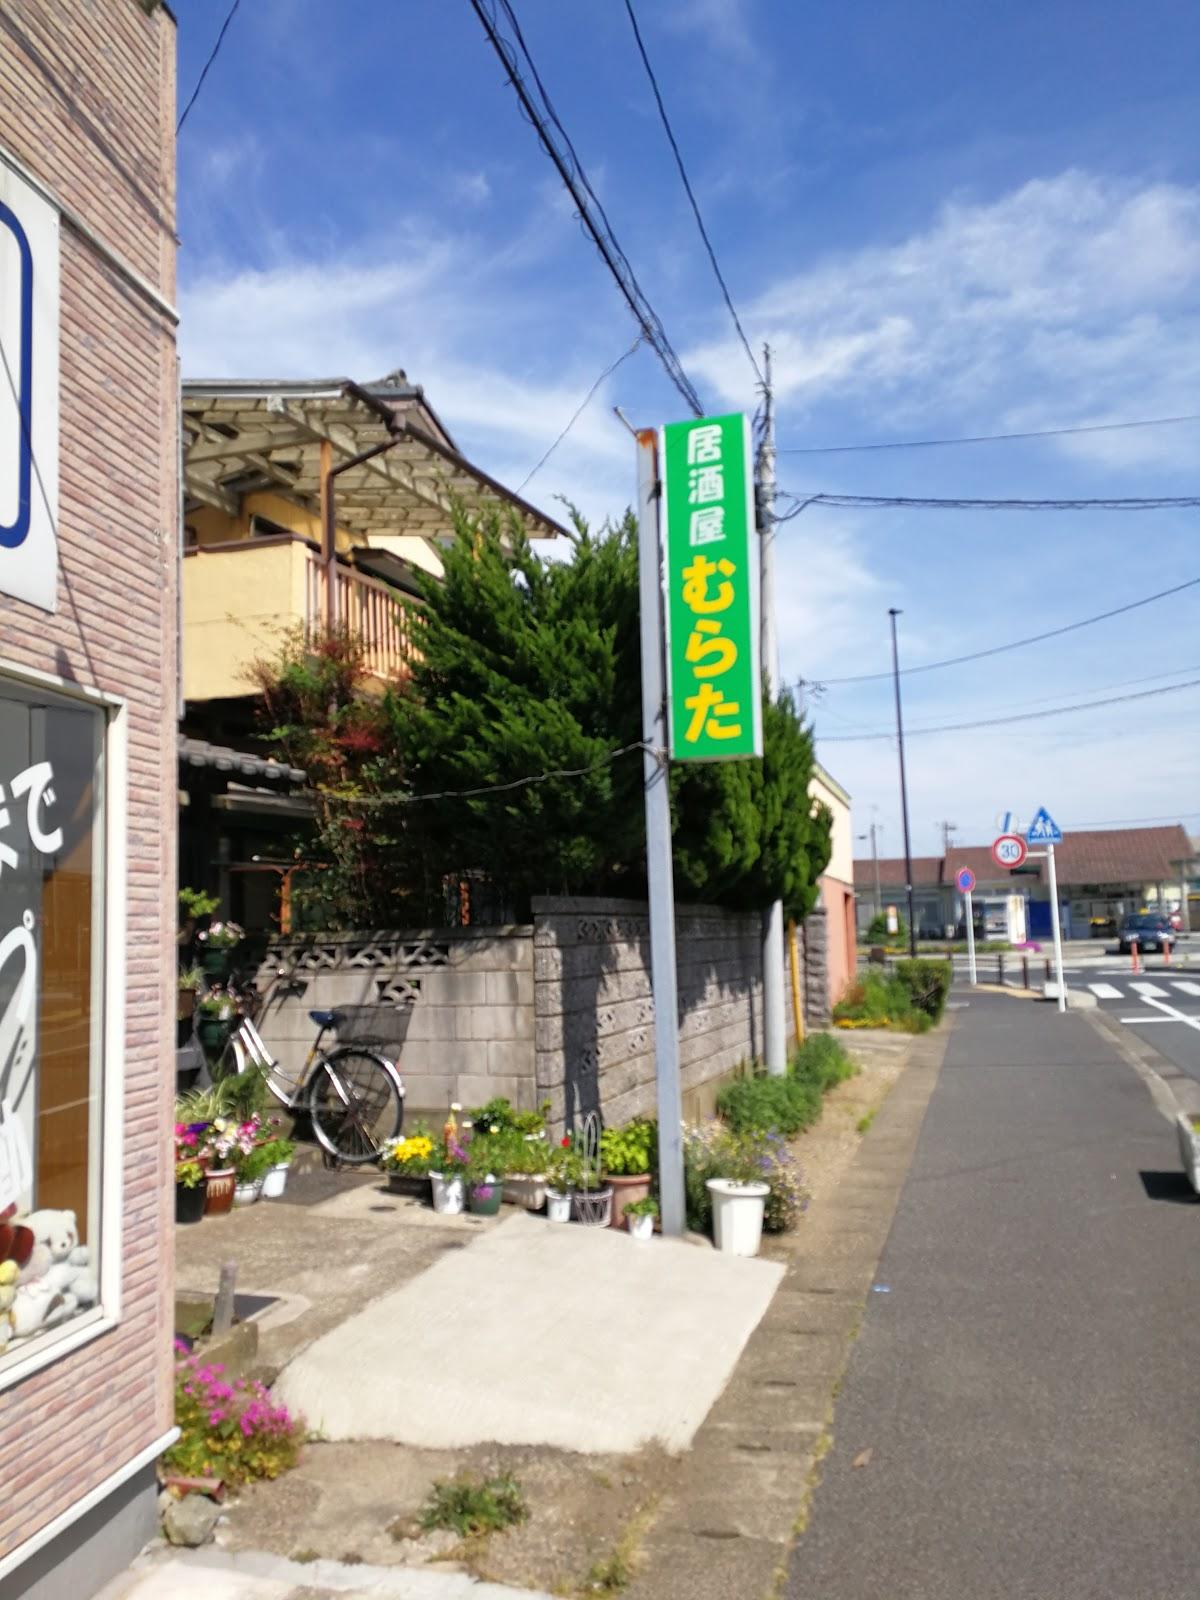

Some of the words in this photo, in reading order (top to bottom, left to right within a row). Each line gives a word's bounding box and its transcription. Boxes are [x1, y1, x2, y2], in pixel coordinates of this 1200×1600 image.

[687, 423, 727, 547] 居酒屋
[682, 555, 742, 743] むらた
[1000, 843, 1020, 860] 30
